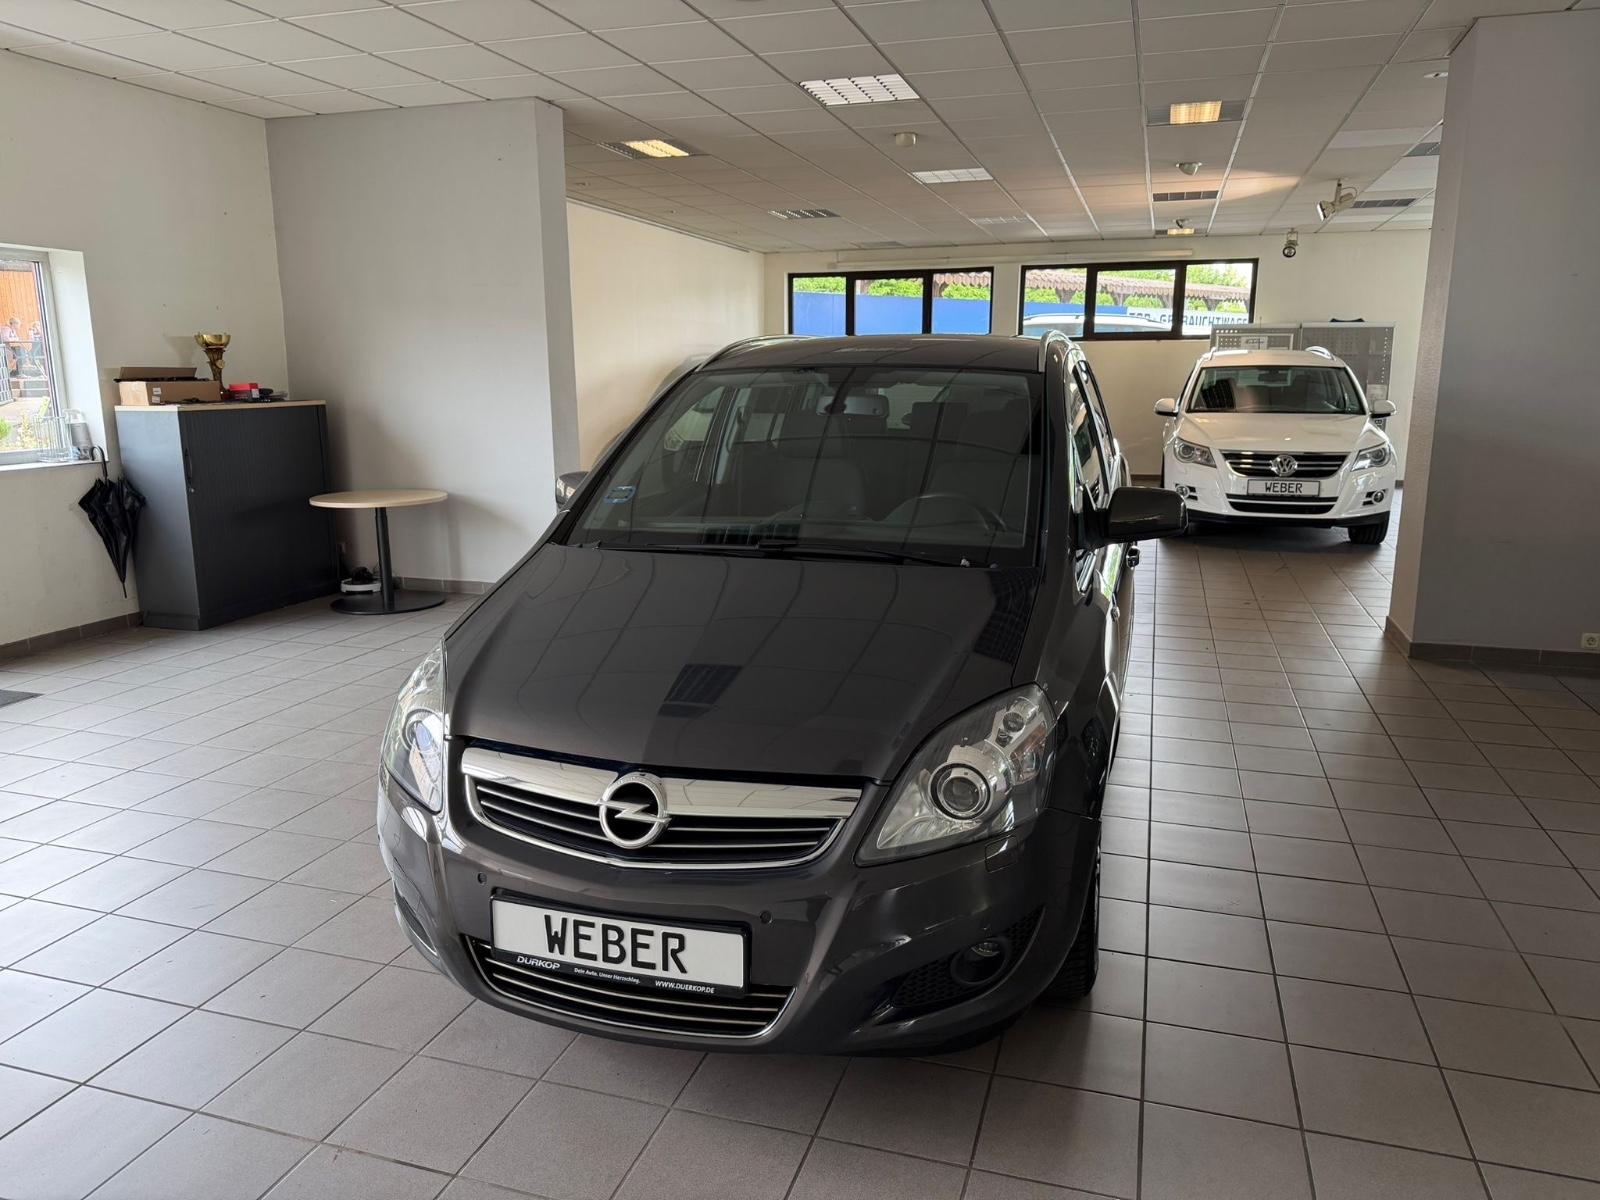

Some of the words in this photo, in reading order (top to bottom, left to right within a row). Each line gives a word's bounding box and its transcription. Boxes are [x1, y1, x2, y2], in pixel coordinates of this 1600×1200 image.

[1264, 482, 1303, 494] WEBER
[544, 914, 688, 974] WEBER
[654, 980, 715, 994] WWW.DUERKOP.DE
